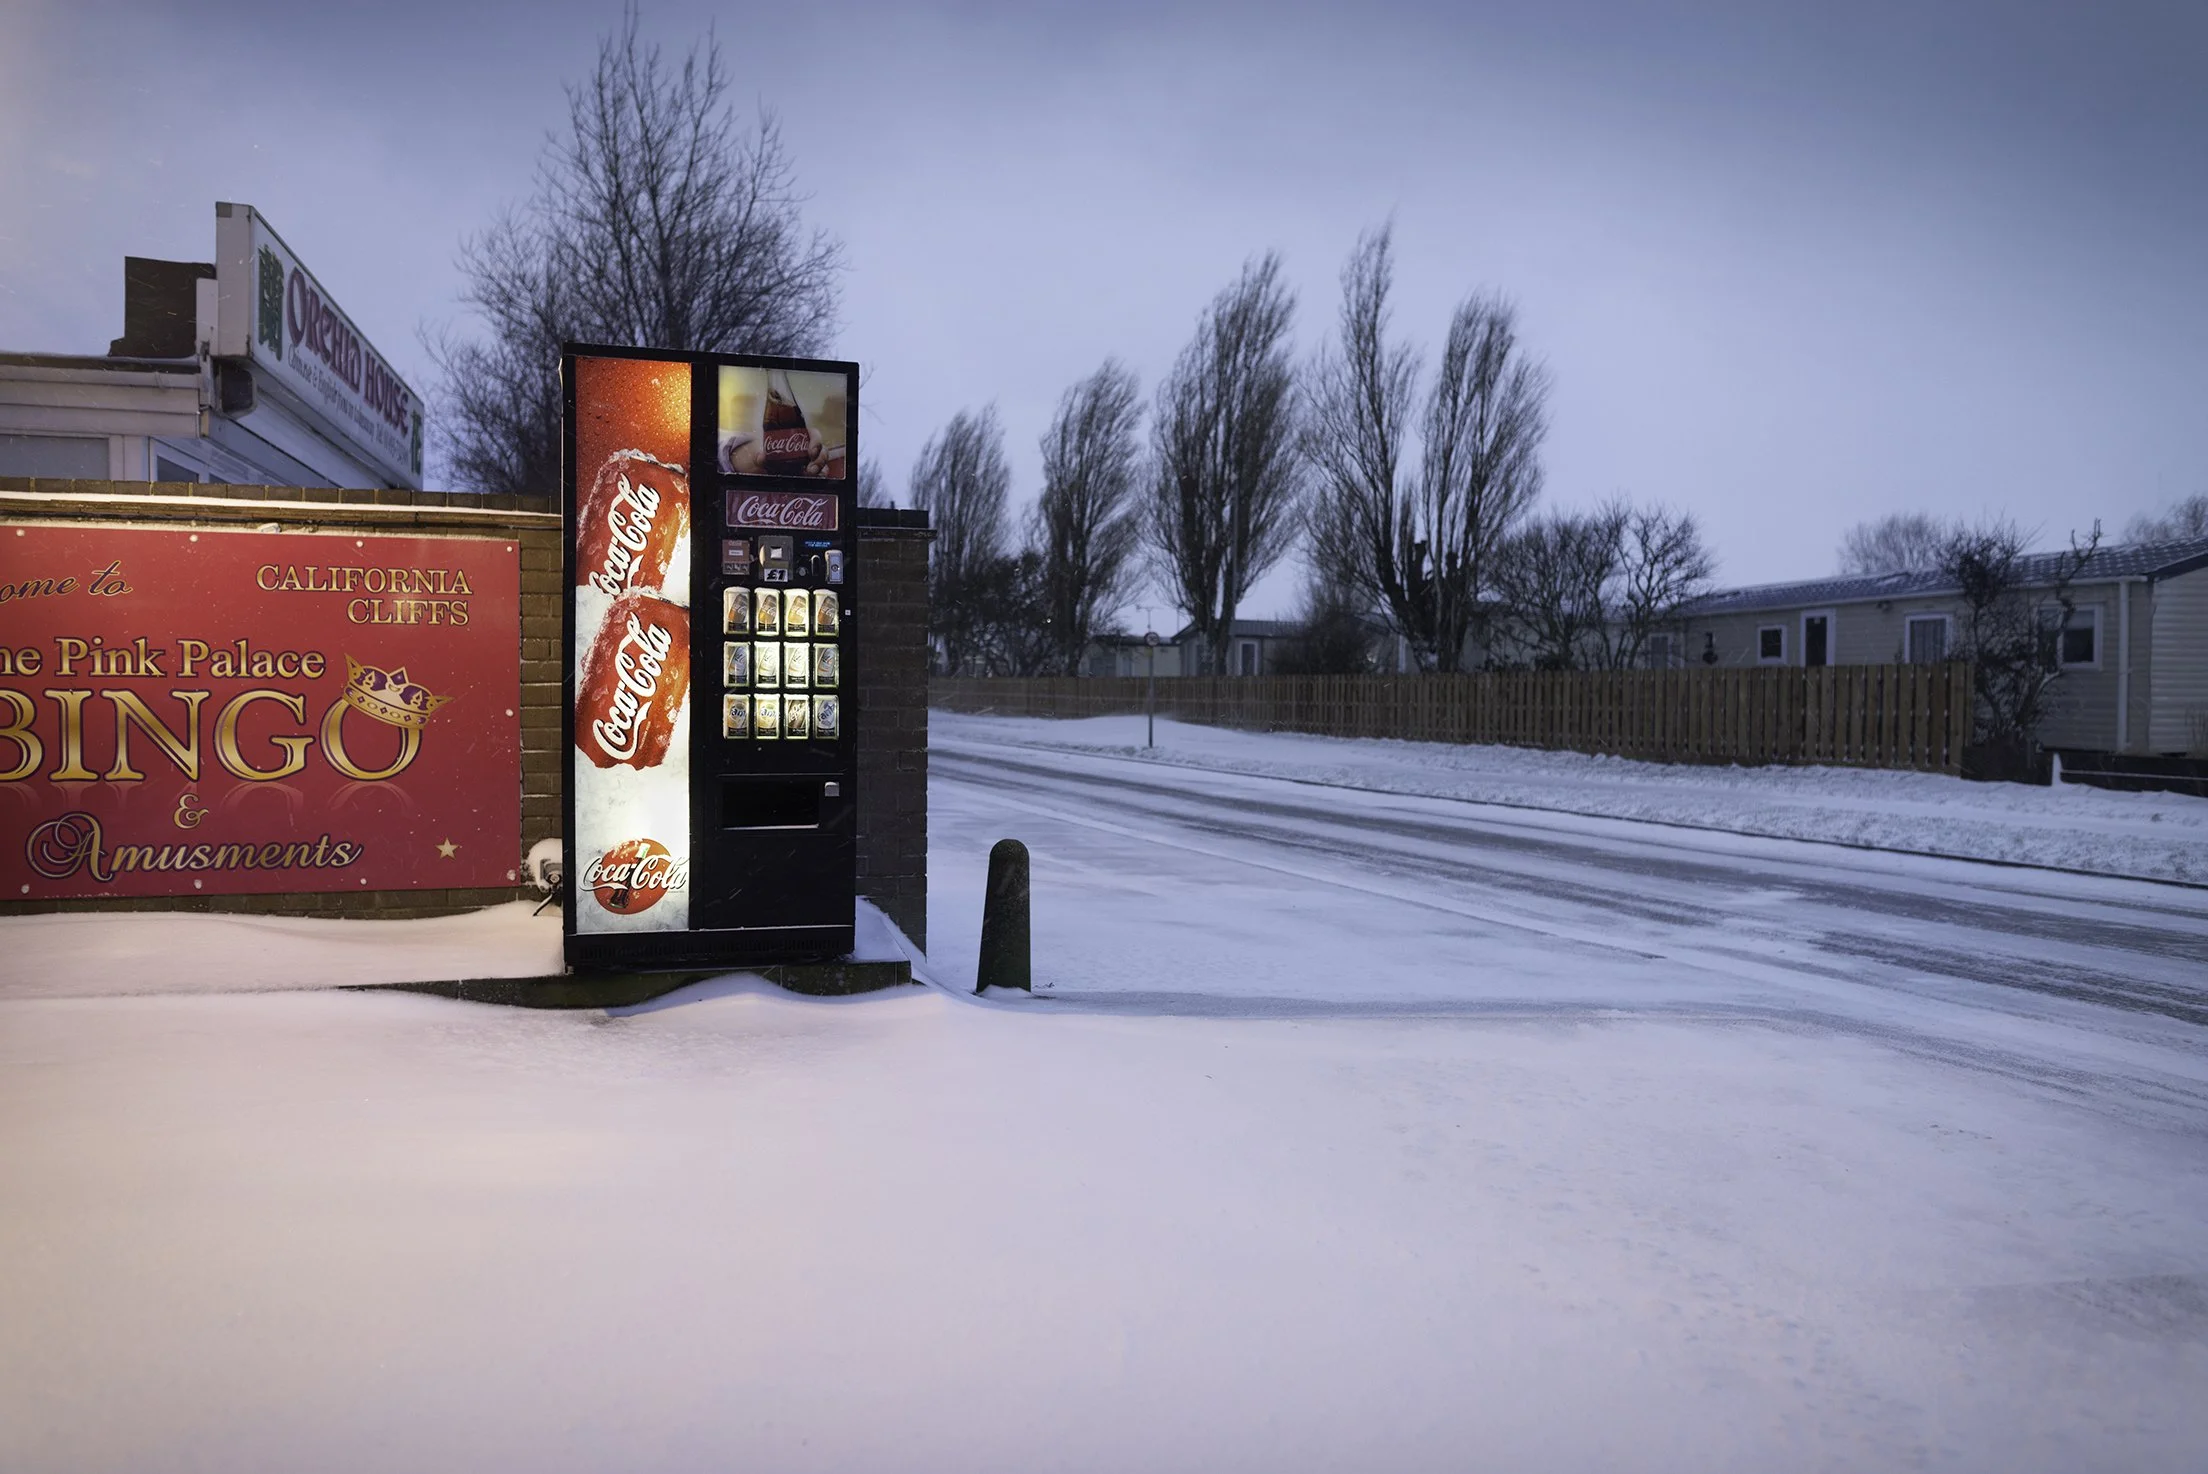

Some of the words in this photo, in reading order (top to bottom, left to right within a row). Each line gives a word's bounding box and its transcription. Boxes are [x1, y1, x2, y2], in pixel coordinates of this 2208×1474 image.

[737, 495, 829, 526] Coca-Cola
[88, 560, 133, 597] to
[256, 564, 473, 596] CALIFORNIA
[766, 569, 786, 580] £1
[346, 598, 470, 627] CLIFFS
[54, 636, 168, 678] Pink
[176, 638, 327, 679] Palace
[592, 611, 673, 761] Coca-Cola
[0, 687, 424, 783] BINGO
[173, 794, 210, 829] &
[24, 810, 364, 883] Amusments
[580, 856, 689, 892] Coca-Cola
